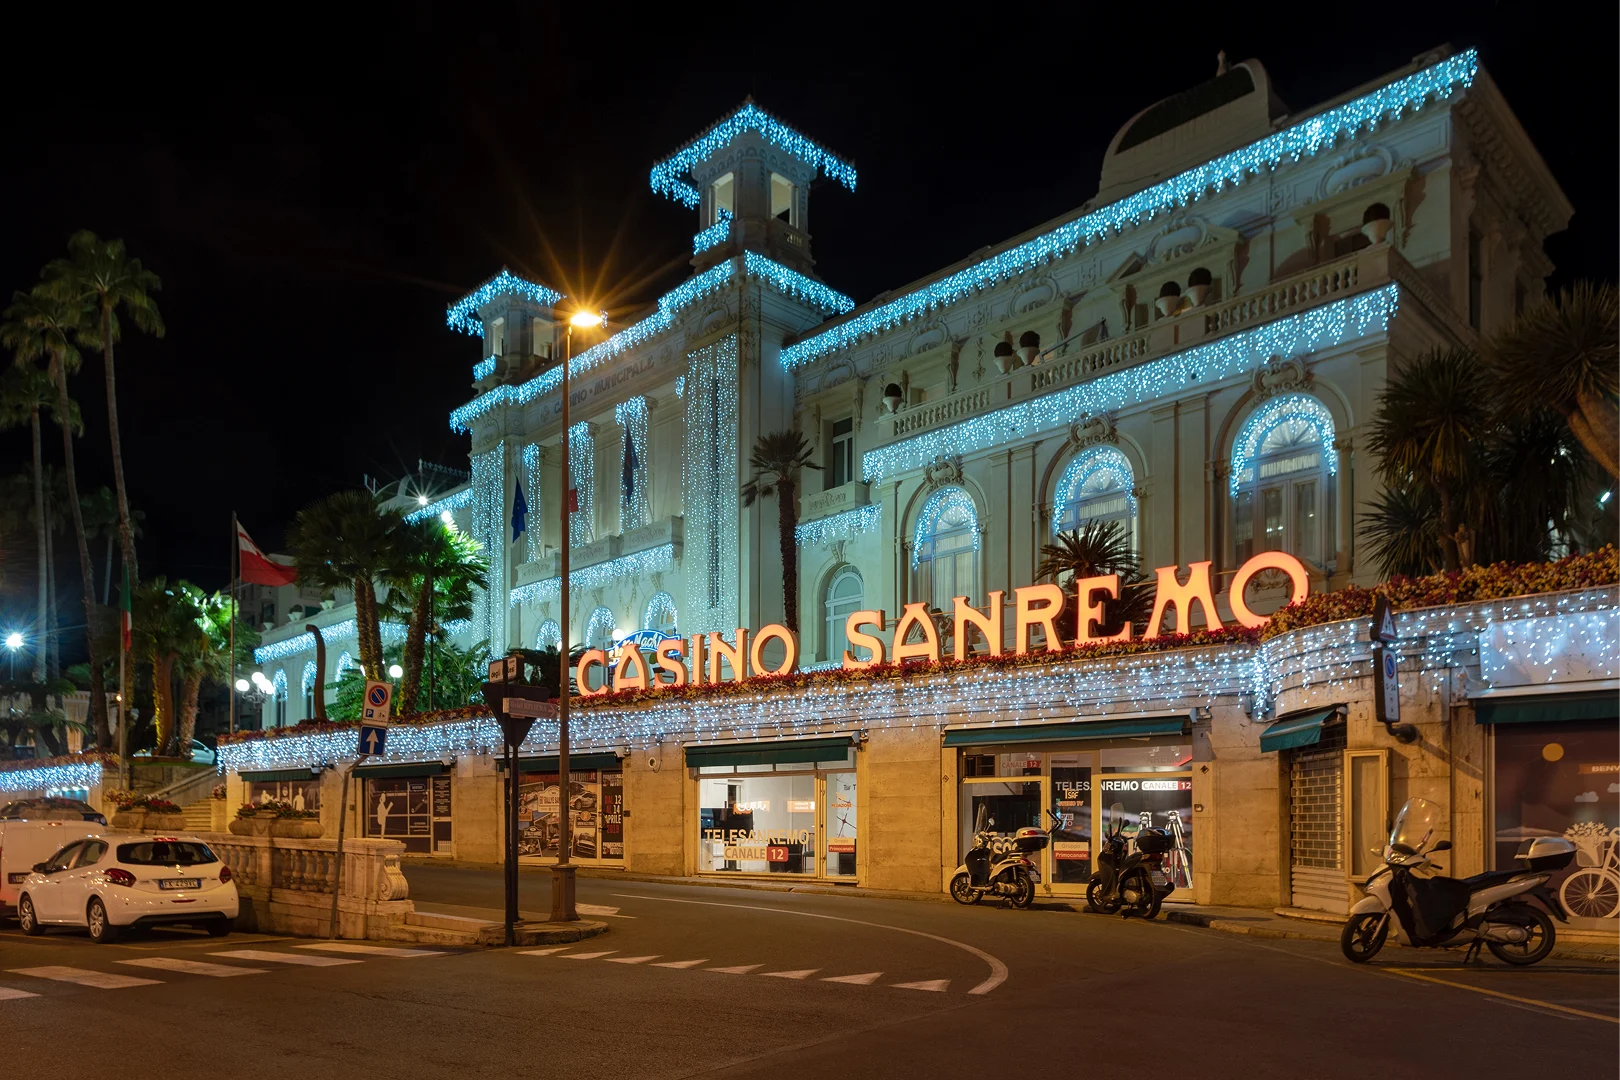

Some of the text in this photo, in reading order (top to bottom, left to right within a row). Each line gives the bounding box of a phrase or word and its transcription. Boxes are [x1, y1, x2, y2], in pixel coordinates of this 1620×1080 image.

[554, 356, 655, 414] CINO MUNICIPALE
[576, 551, 1309, 696] CASINO SANREMO
[1002, 761, 1026, 769] CANALE
[1143, 782, 1177, 790] CANALE
[1181, 781, 1191, 789] 12
[614, 795, 621, 804] 12
[613, 805, 620, 814] 14
[704, 829, 809, 845] TELESANREMO
[724, 848, 784, 860] CANALE 12
